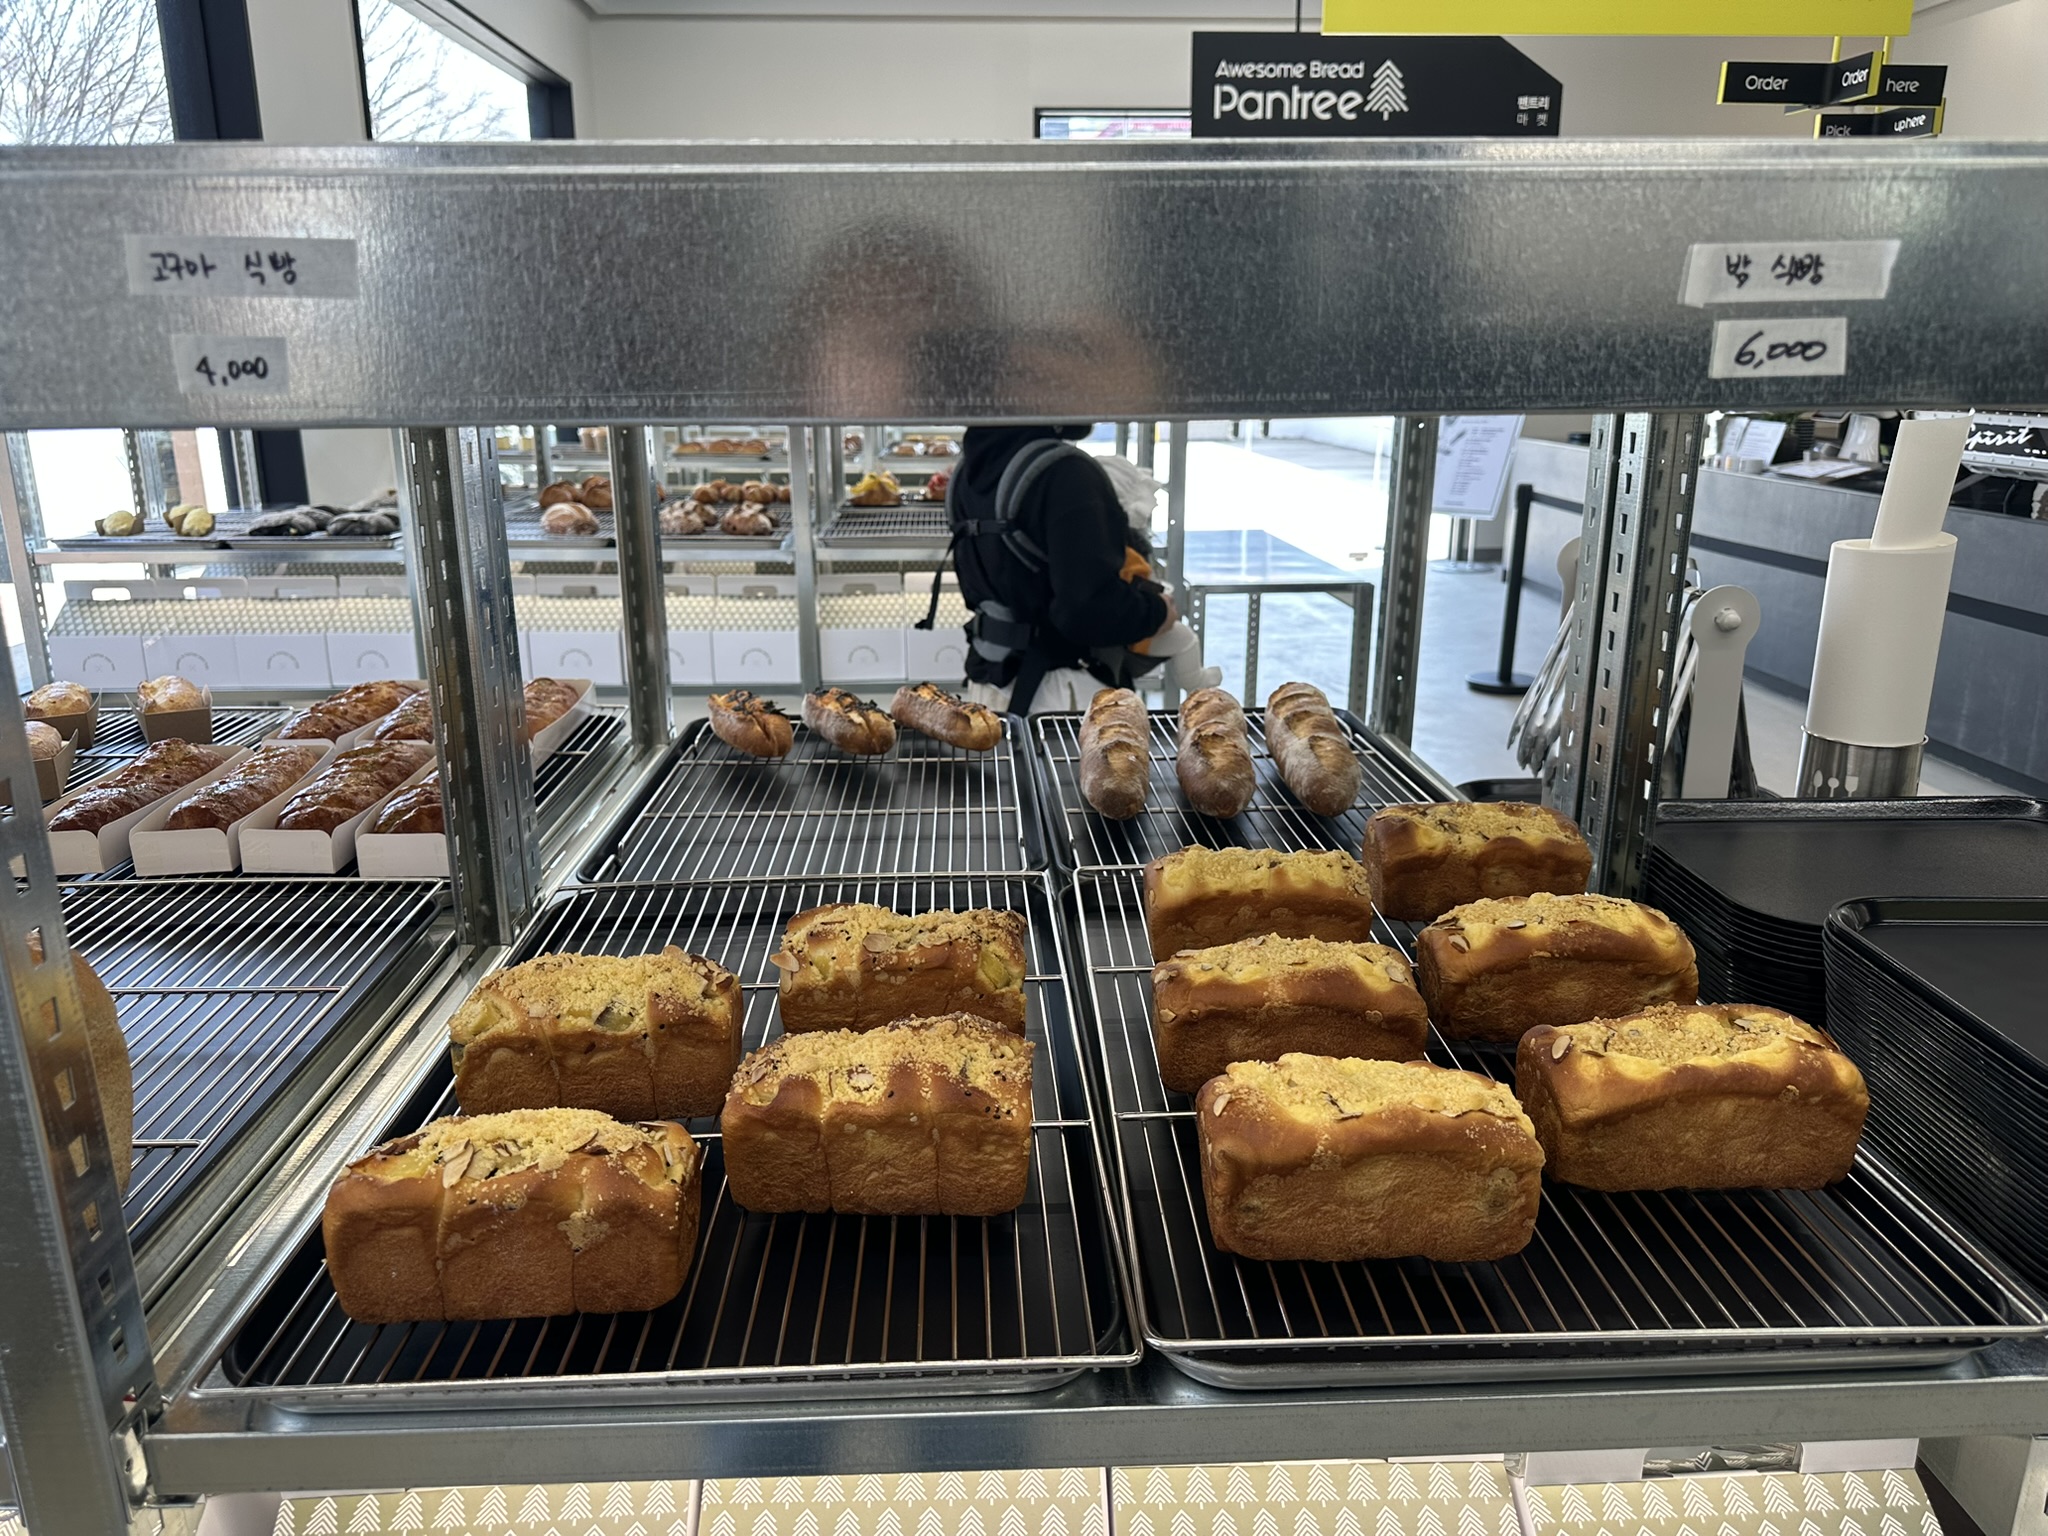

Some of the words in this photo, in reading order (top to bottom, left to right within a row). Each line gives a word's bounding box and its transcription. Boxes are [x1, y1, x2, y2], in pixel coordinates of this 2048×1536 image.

[1215, 58, 1307, 79] Awesome
[1309, 59, 1365, 79] Bread
[1841, 68, 1869, 87] Order
[1745, 75, 1789, 91] Order
[1885, 78, 1920, 92] here
[1213, 83, 1364, 121] Pantree
[150, 252, 217, 282] 고구마
[245, 250, 297, 285] 식빵
[1734, 330, 1828, 370] 6,000
[196, 356, 269, 387] 4,000
